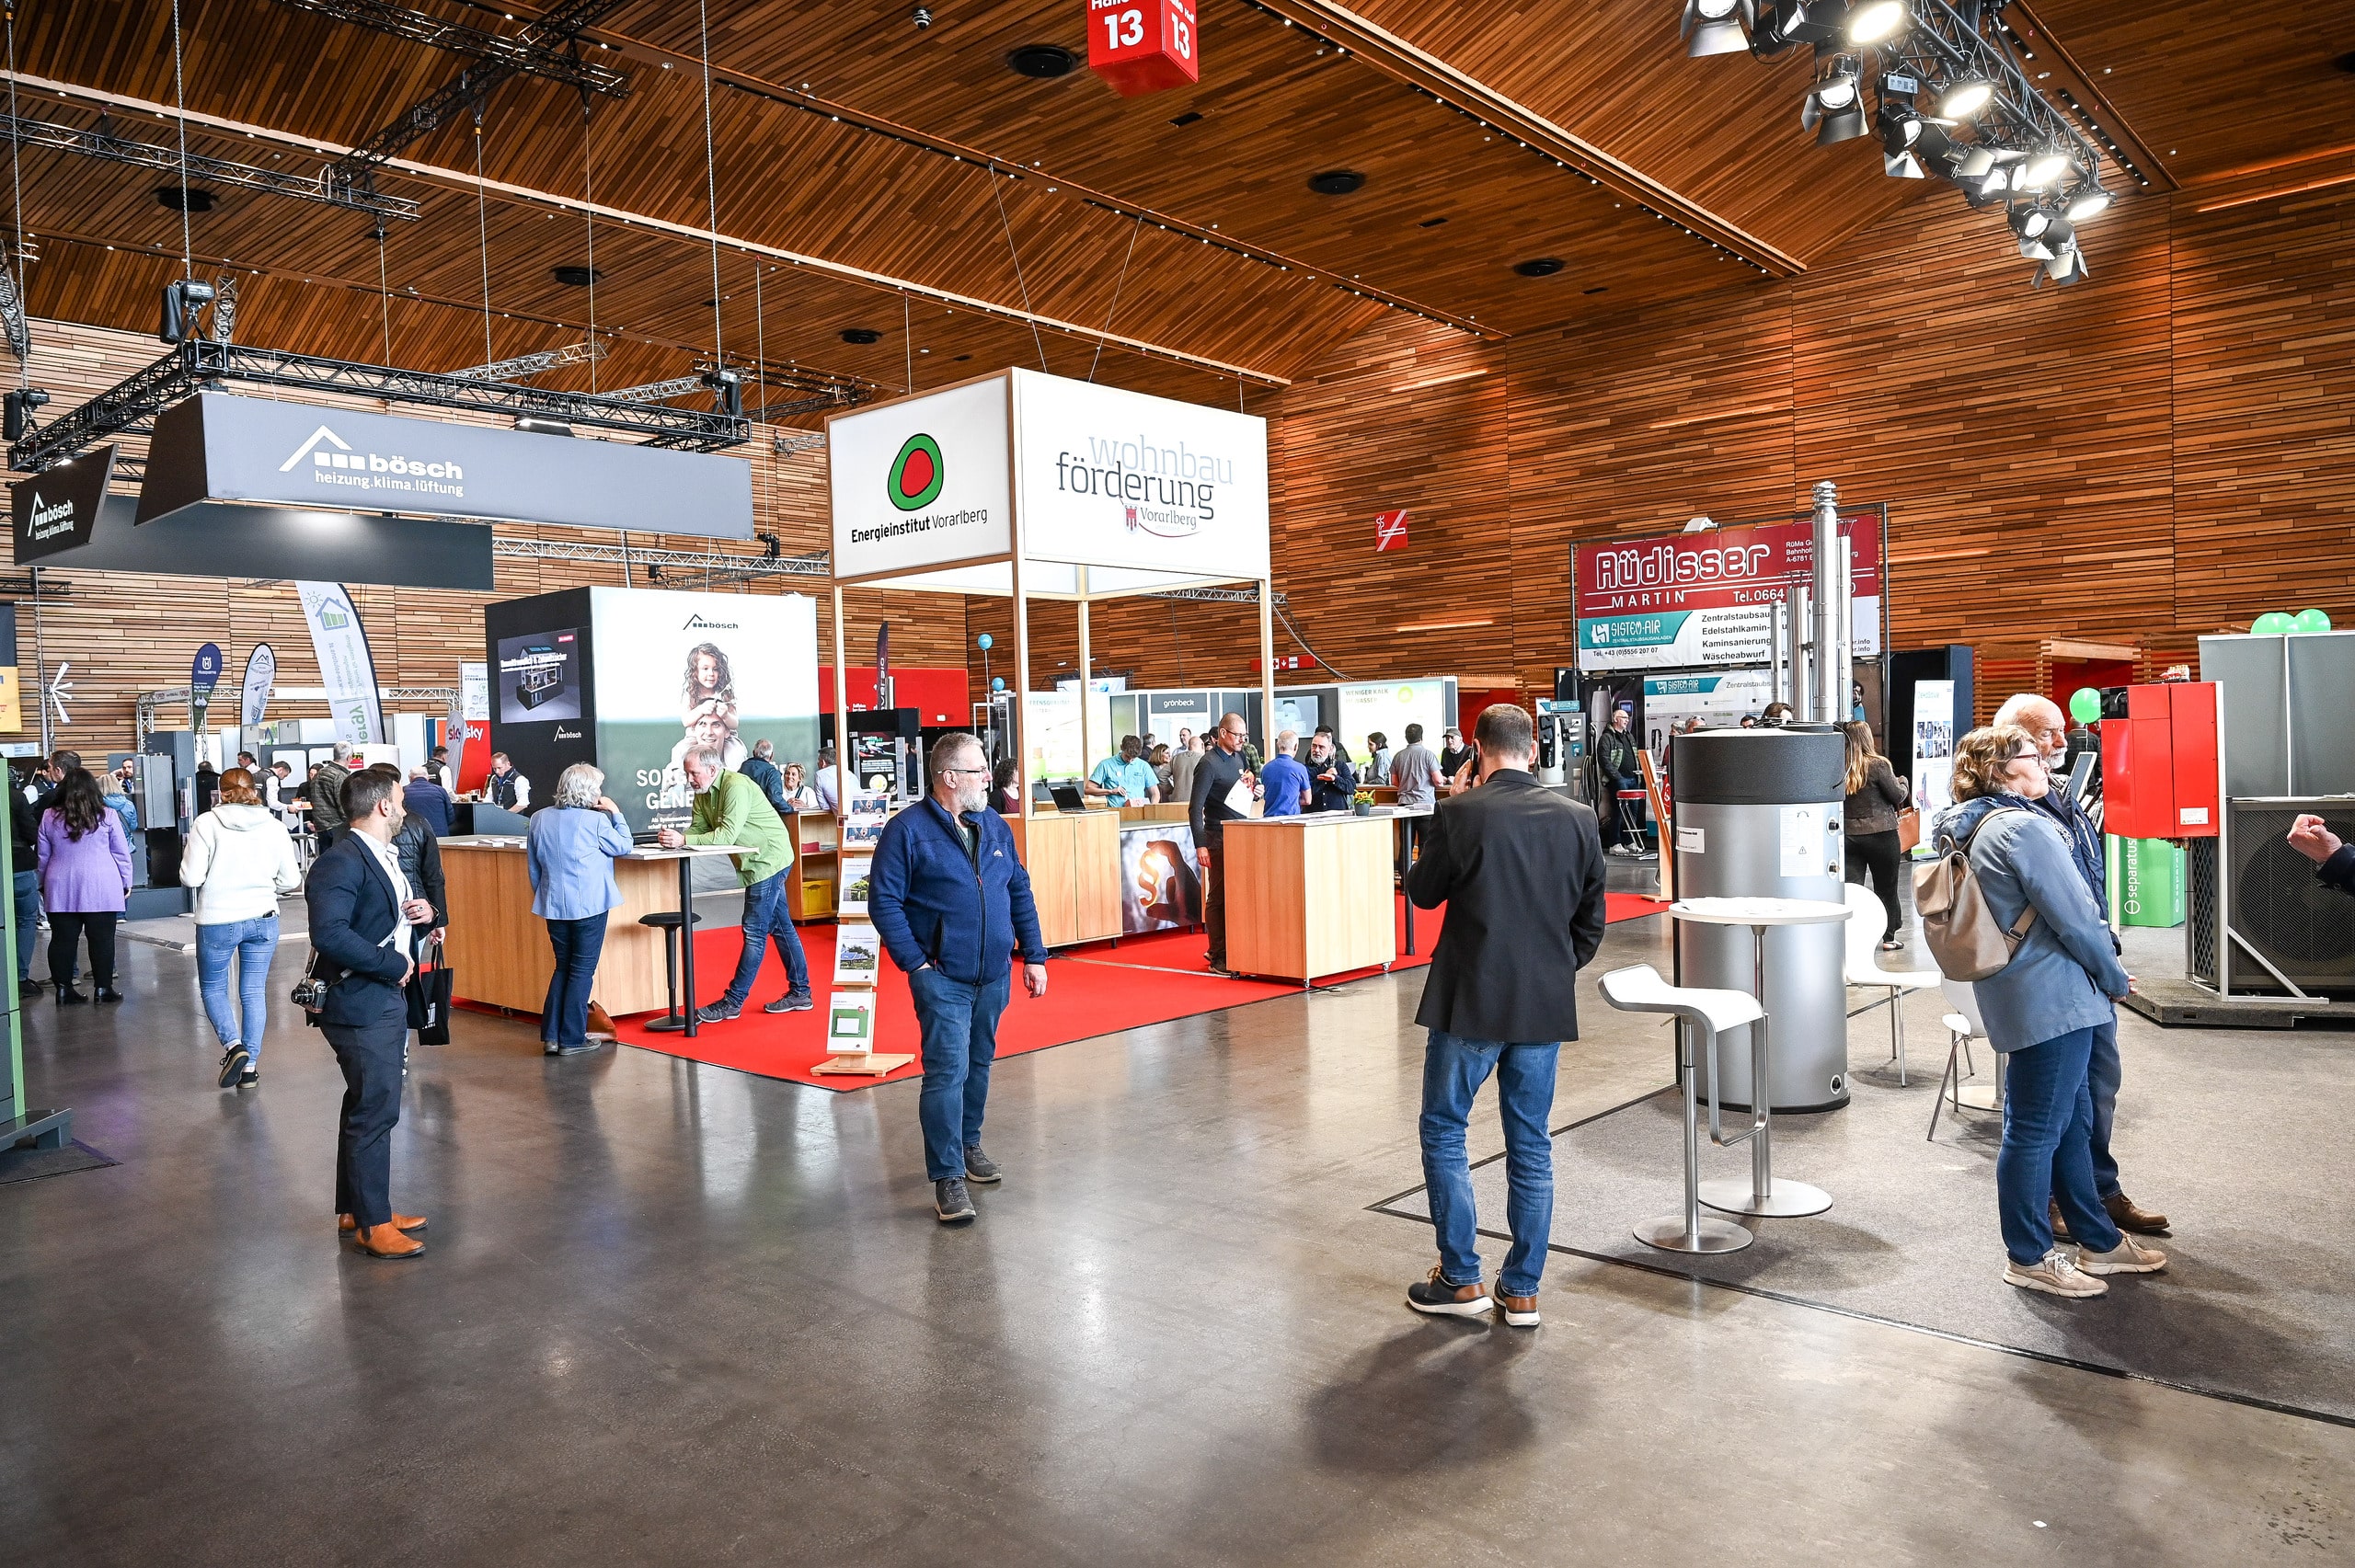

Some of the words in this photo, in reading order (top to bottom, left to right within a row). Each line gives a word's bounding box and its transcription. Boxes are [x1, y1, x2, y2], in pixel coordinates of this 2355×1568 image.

[1104, 9, 1144, 50] 13
[1171, 11, 1191, 59] 13
[369, 453, 464, 480] bösch
[1088, 434, 1234, 485] wohnbau
[315, 470, 465, 498] heizung.klima.lüftung
[1056, 452, 1214, 521] förderung
[47, 499, 74, 522] bösch
[1140, 507, 1197, 531] Vorarlberg
[851, 516, 931, 544] Energieinstitut
[931, 509, 988, 530] Vorarlberg
[1596, 544, 1771, 590] Rüdisser
[1611, 590, 1685, 608] MARTIN
[708, 621, 739, 630] bösch
[1702, 637, 1772, 648] Kaminsanierung
[1702, 649, 1766, 660] Wäscheabwurf
